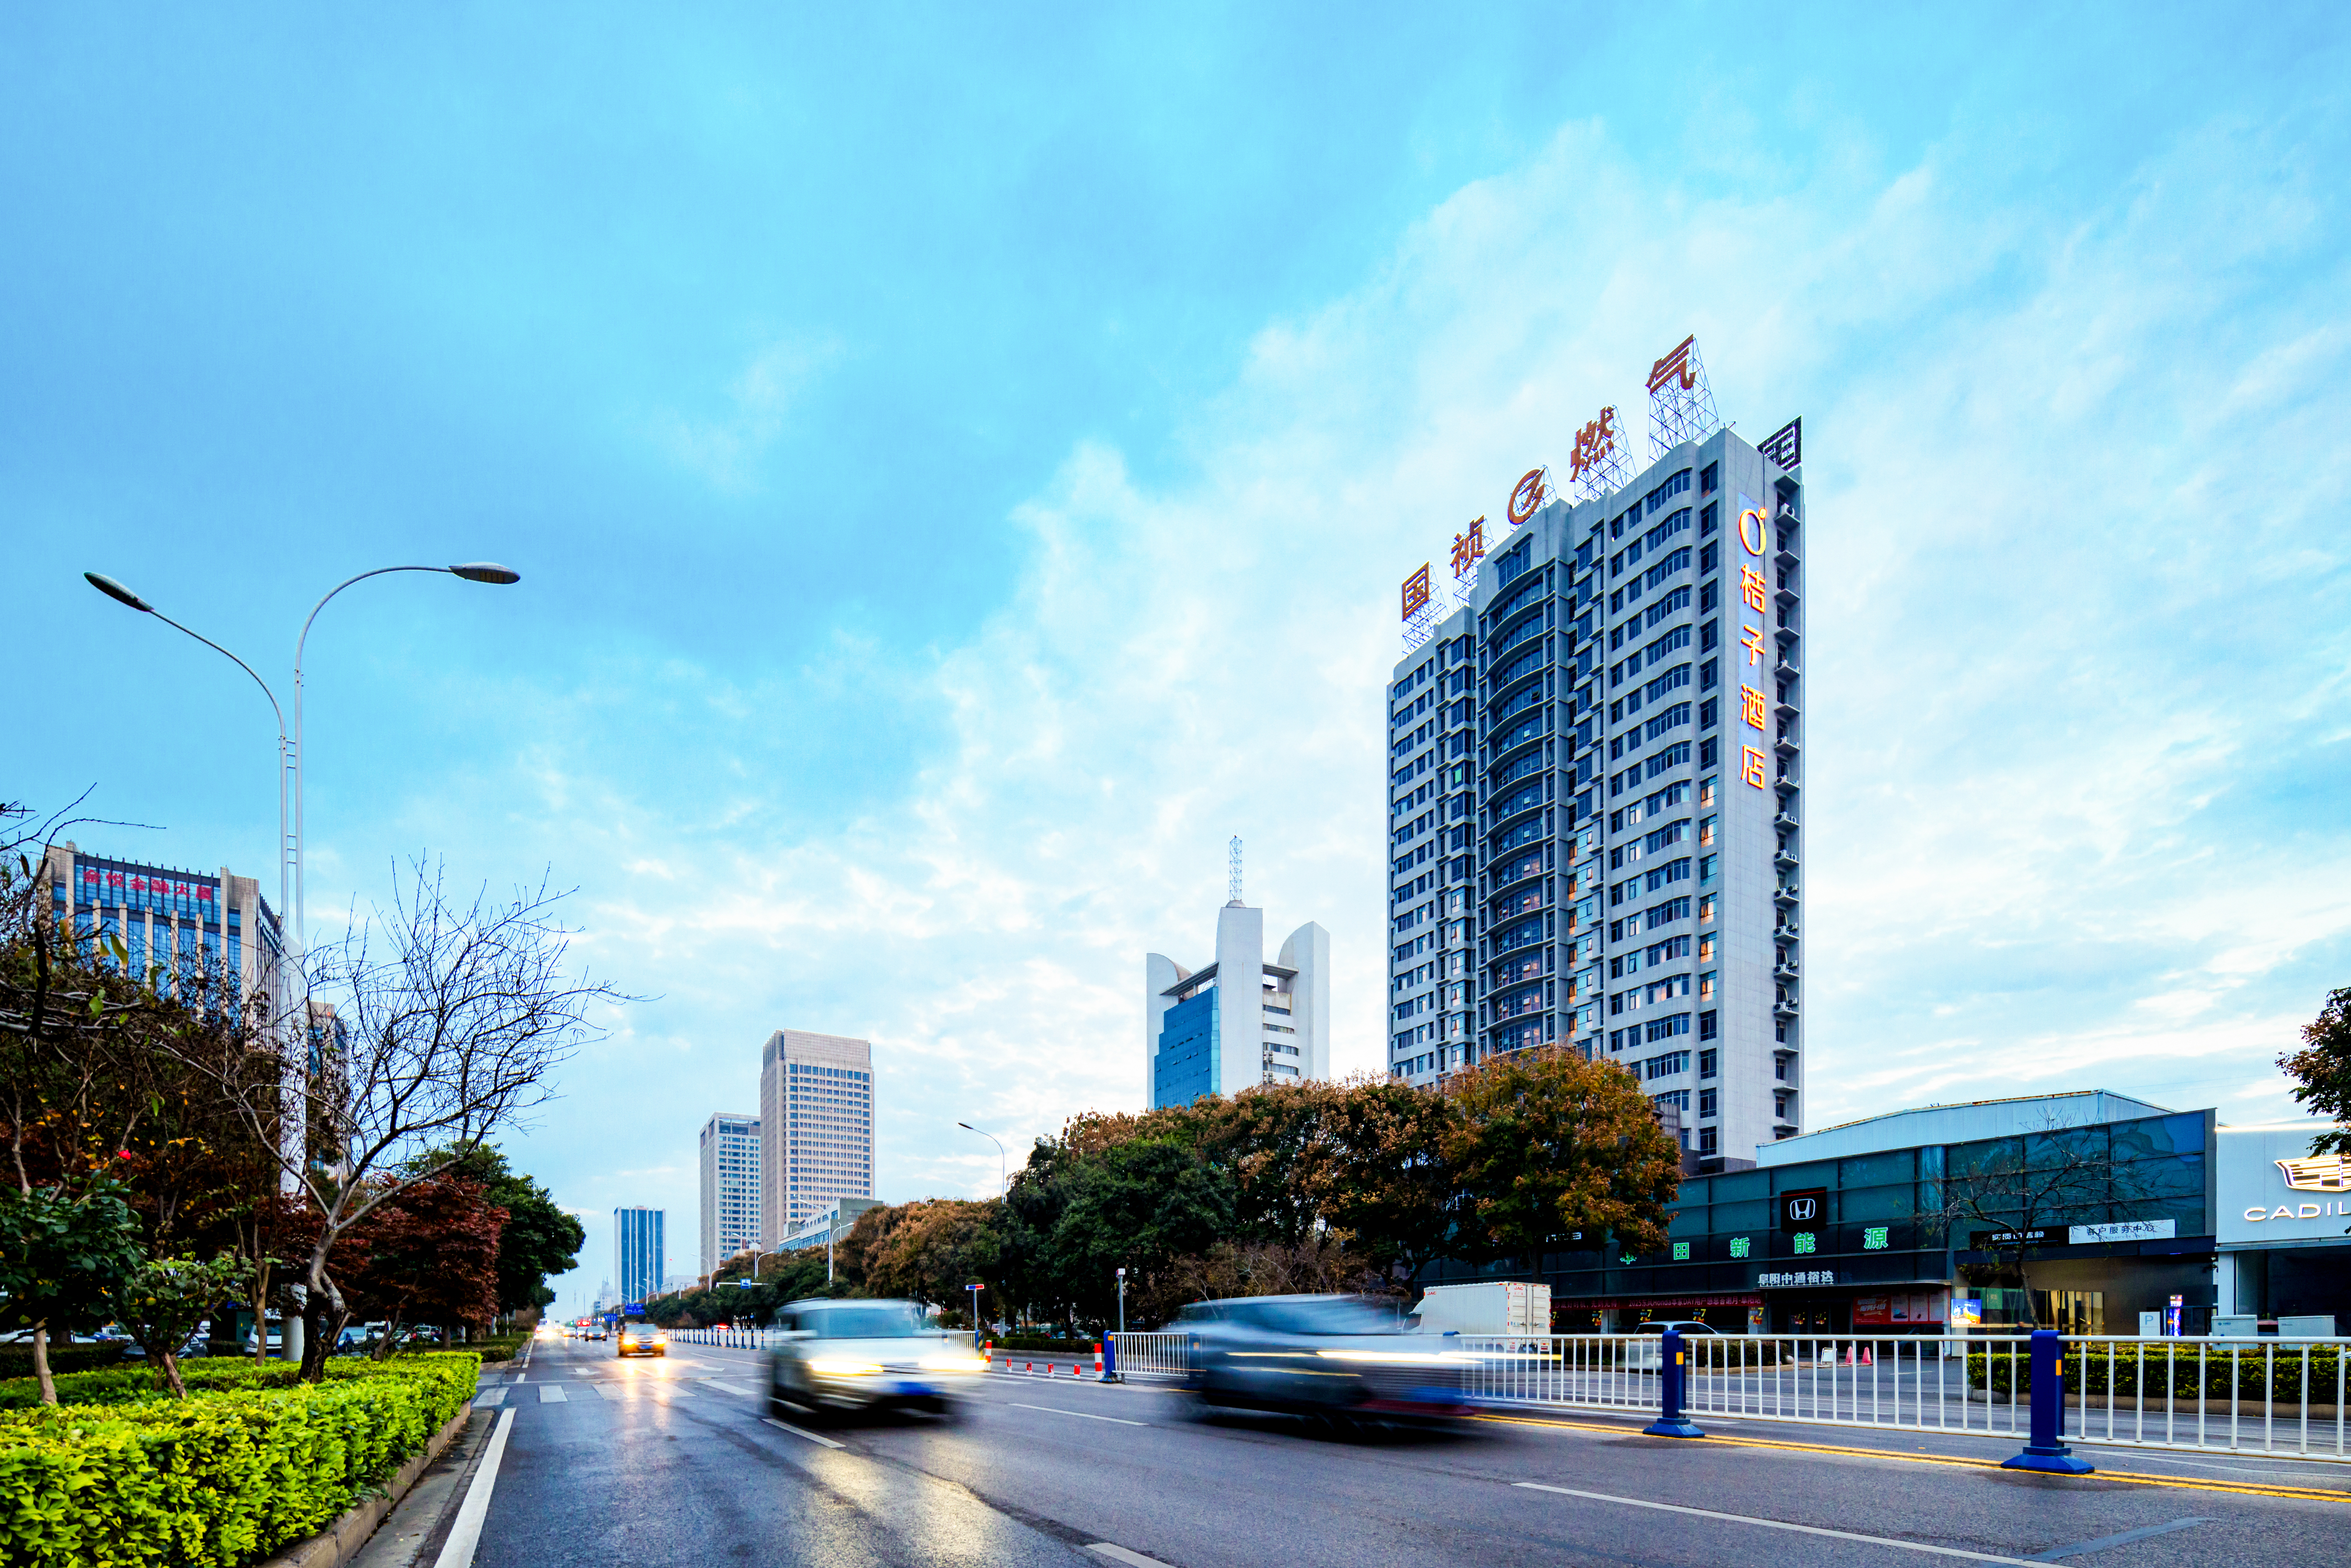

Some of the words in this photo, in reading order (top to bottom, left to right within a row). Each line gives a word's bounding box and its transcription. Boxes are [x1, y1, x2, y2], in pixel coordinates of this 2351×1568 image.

[1741, 563, 1766, 790] 桔子酒店
[83, 869, 212, 901] 金悦金融大厦
[1758, 1270, 1834, 1285] 阜阳中通裕达
[2145, 1315, 2153, 1324] P
